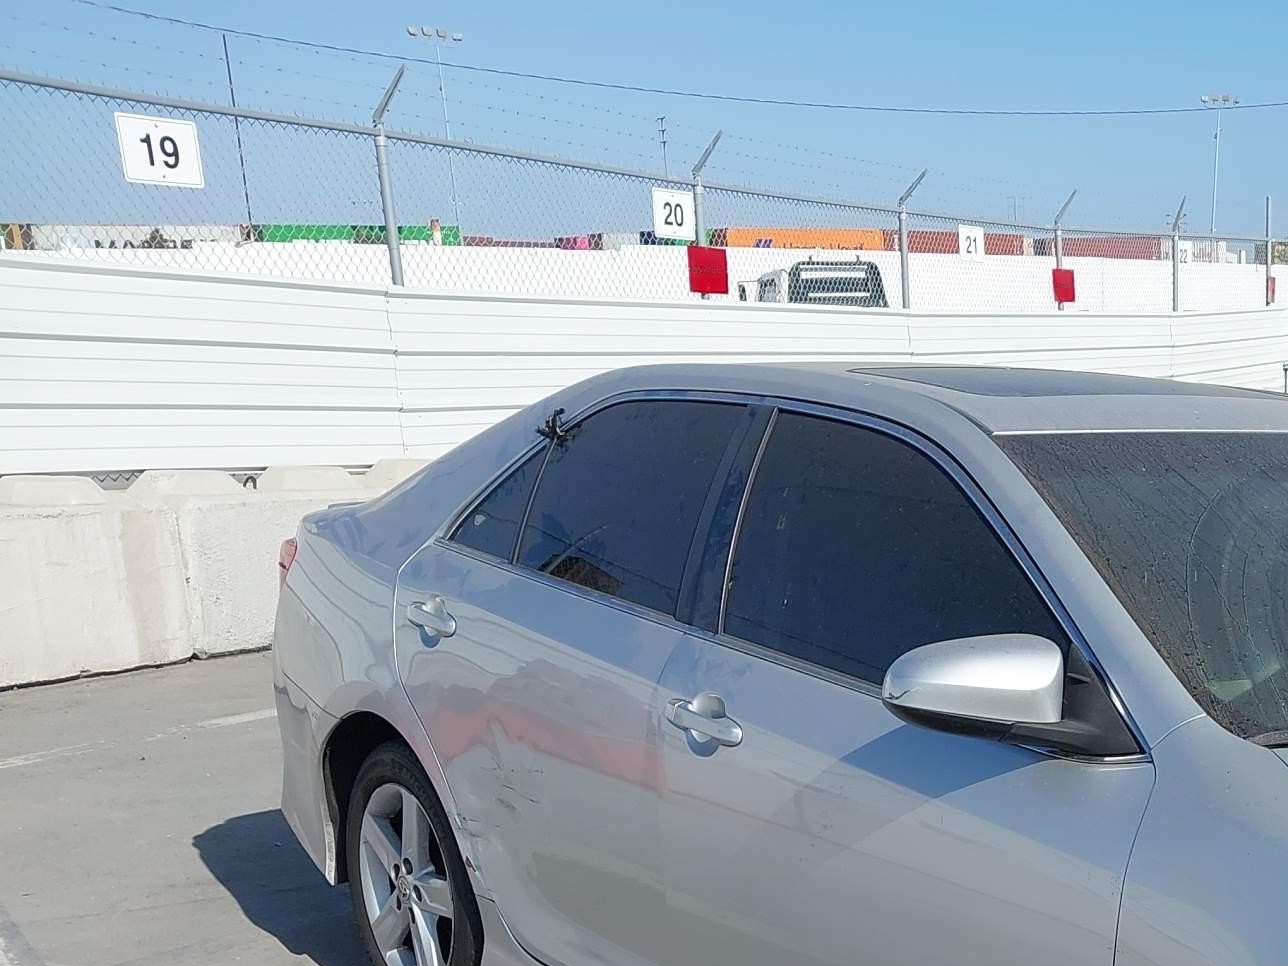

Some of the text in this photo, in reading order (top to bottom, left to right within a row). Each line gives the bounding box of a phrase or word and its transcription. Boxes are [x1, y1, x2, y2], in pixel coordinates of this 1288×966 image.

[139, 132, 180, 169] 19
[662, 201, 684, 227] 20
[964, 235, 978, 255] 21
[1179, 249, 1188, 263] 22
